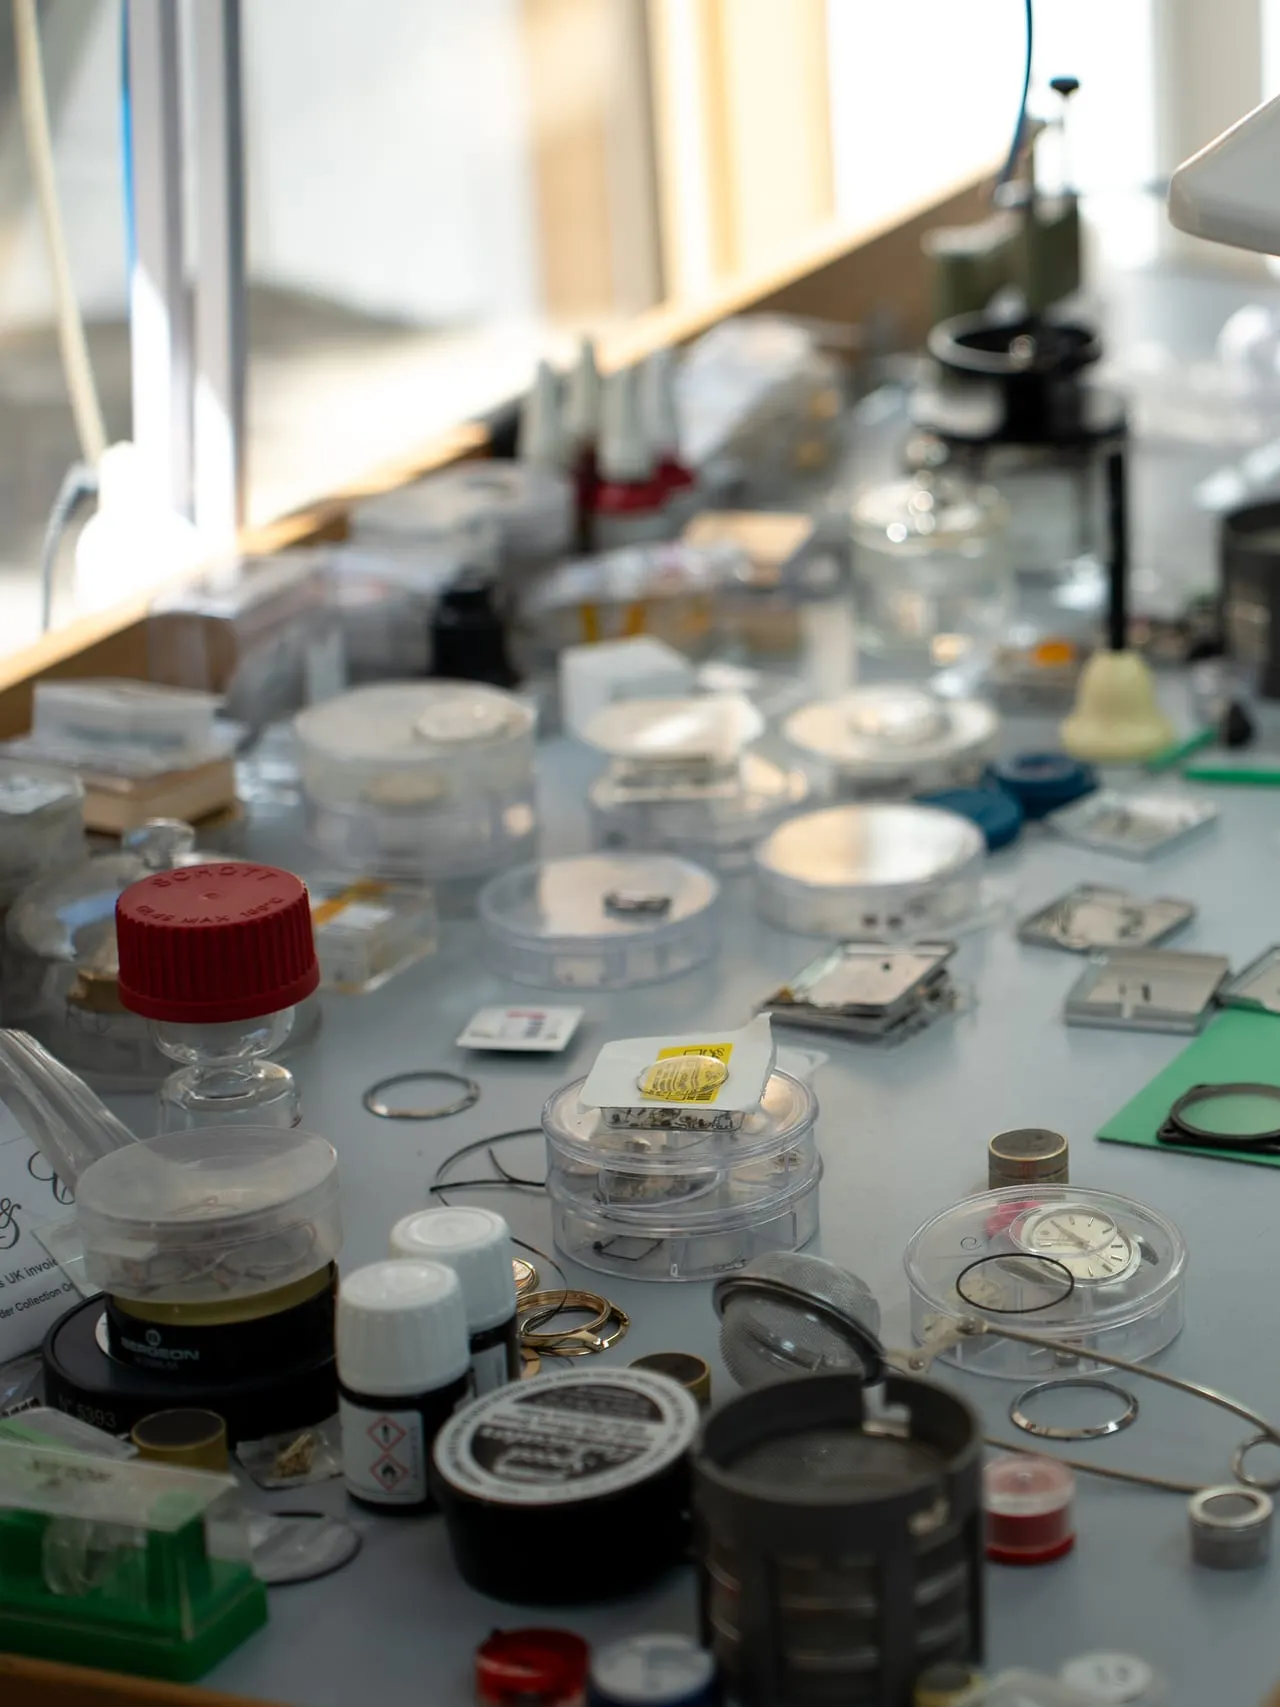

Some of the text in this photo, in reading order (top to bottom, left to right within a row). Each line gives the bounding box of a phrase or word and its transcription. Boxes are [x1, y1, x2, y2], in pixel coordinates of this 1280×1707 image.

[152, 865, 279, 888] SCHOTT
[181, 915, 231, 924] MAX
[4, 1270, 26, 1285] UK
[15, 1286, 62, 1313] Collection
